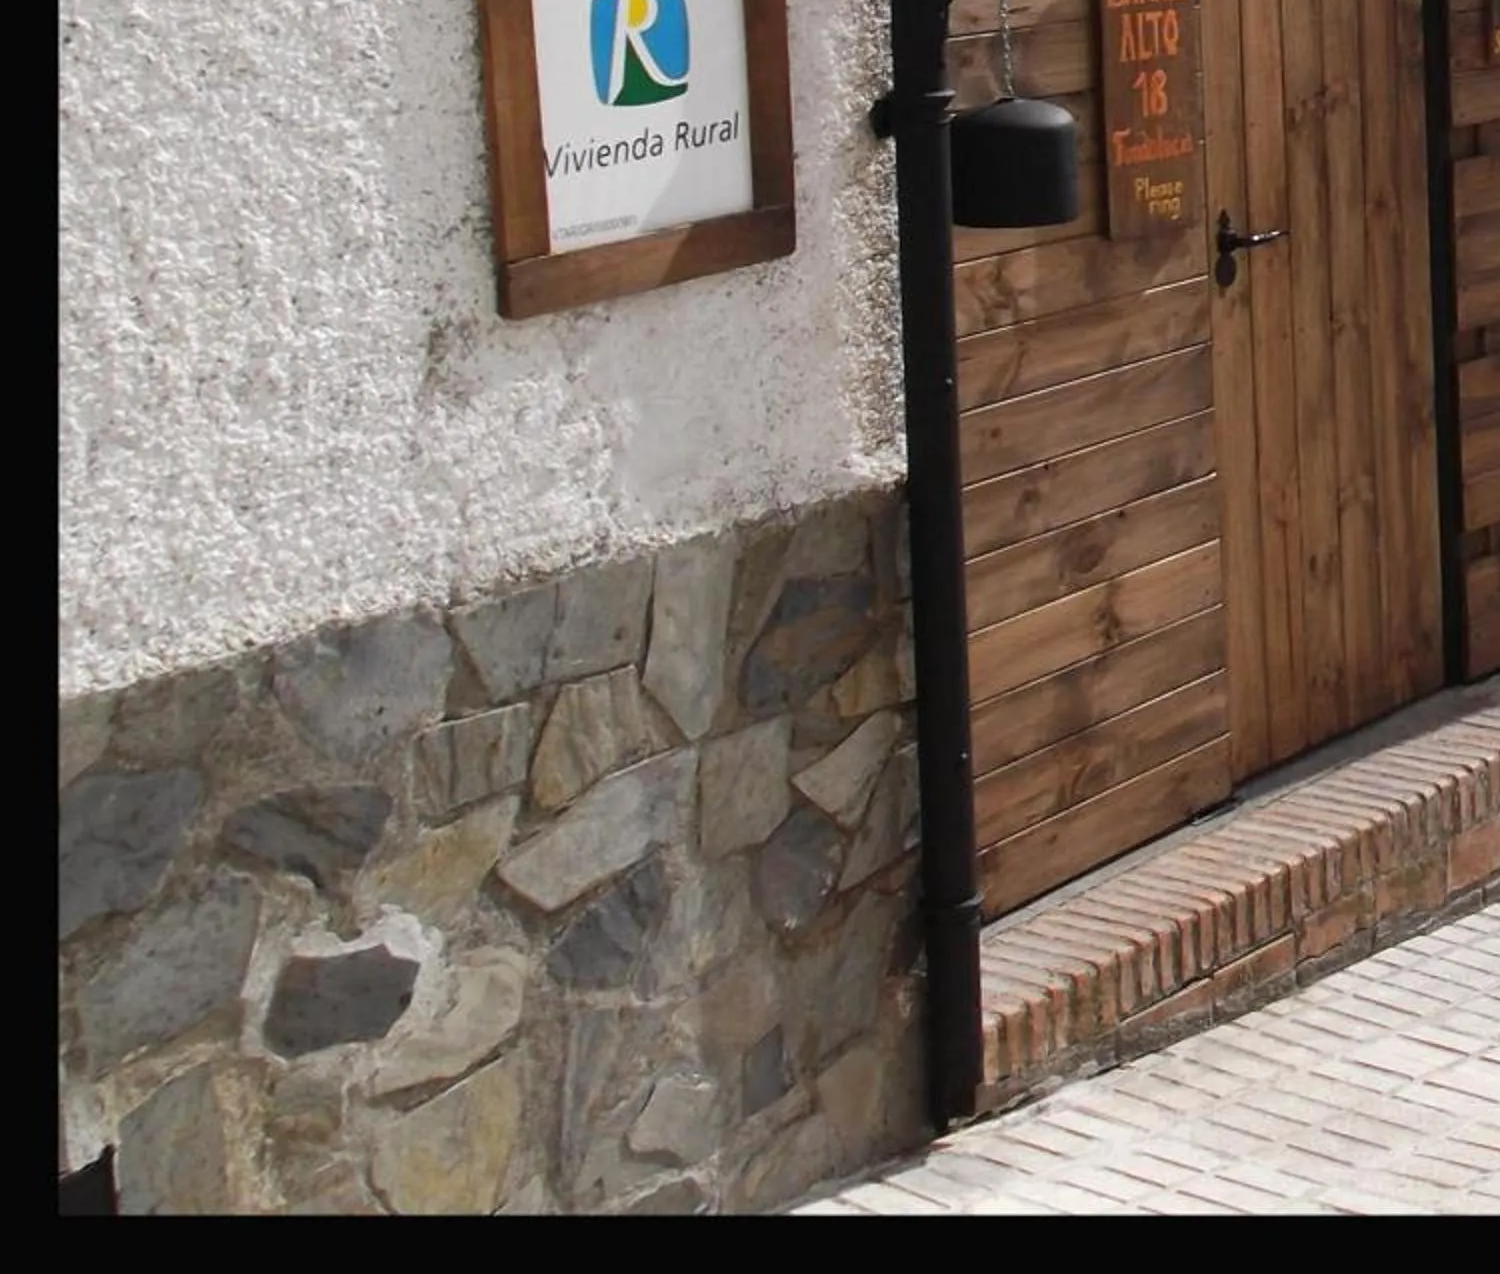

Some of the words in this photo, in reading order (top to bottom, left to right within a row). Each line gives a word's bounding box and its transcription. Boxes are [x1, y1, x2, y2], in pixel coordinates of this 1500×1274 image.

[1118, 9, 1180, 63] ALTO
[1131, 69, 1168, 118] 18
[543, 126, 664, 179] Vivienda
[674, 111, 739, 151] Rural
[1134, 176, 1184, 201] Please
